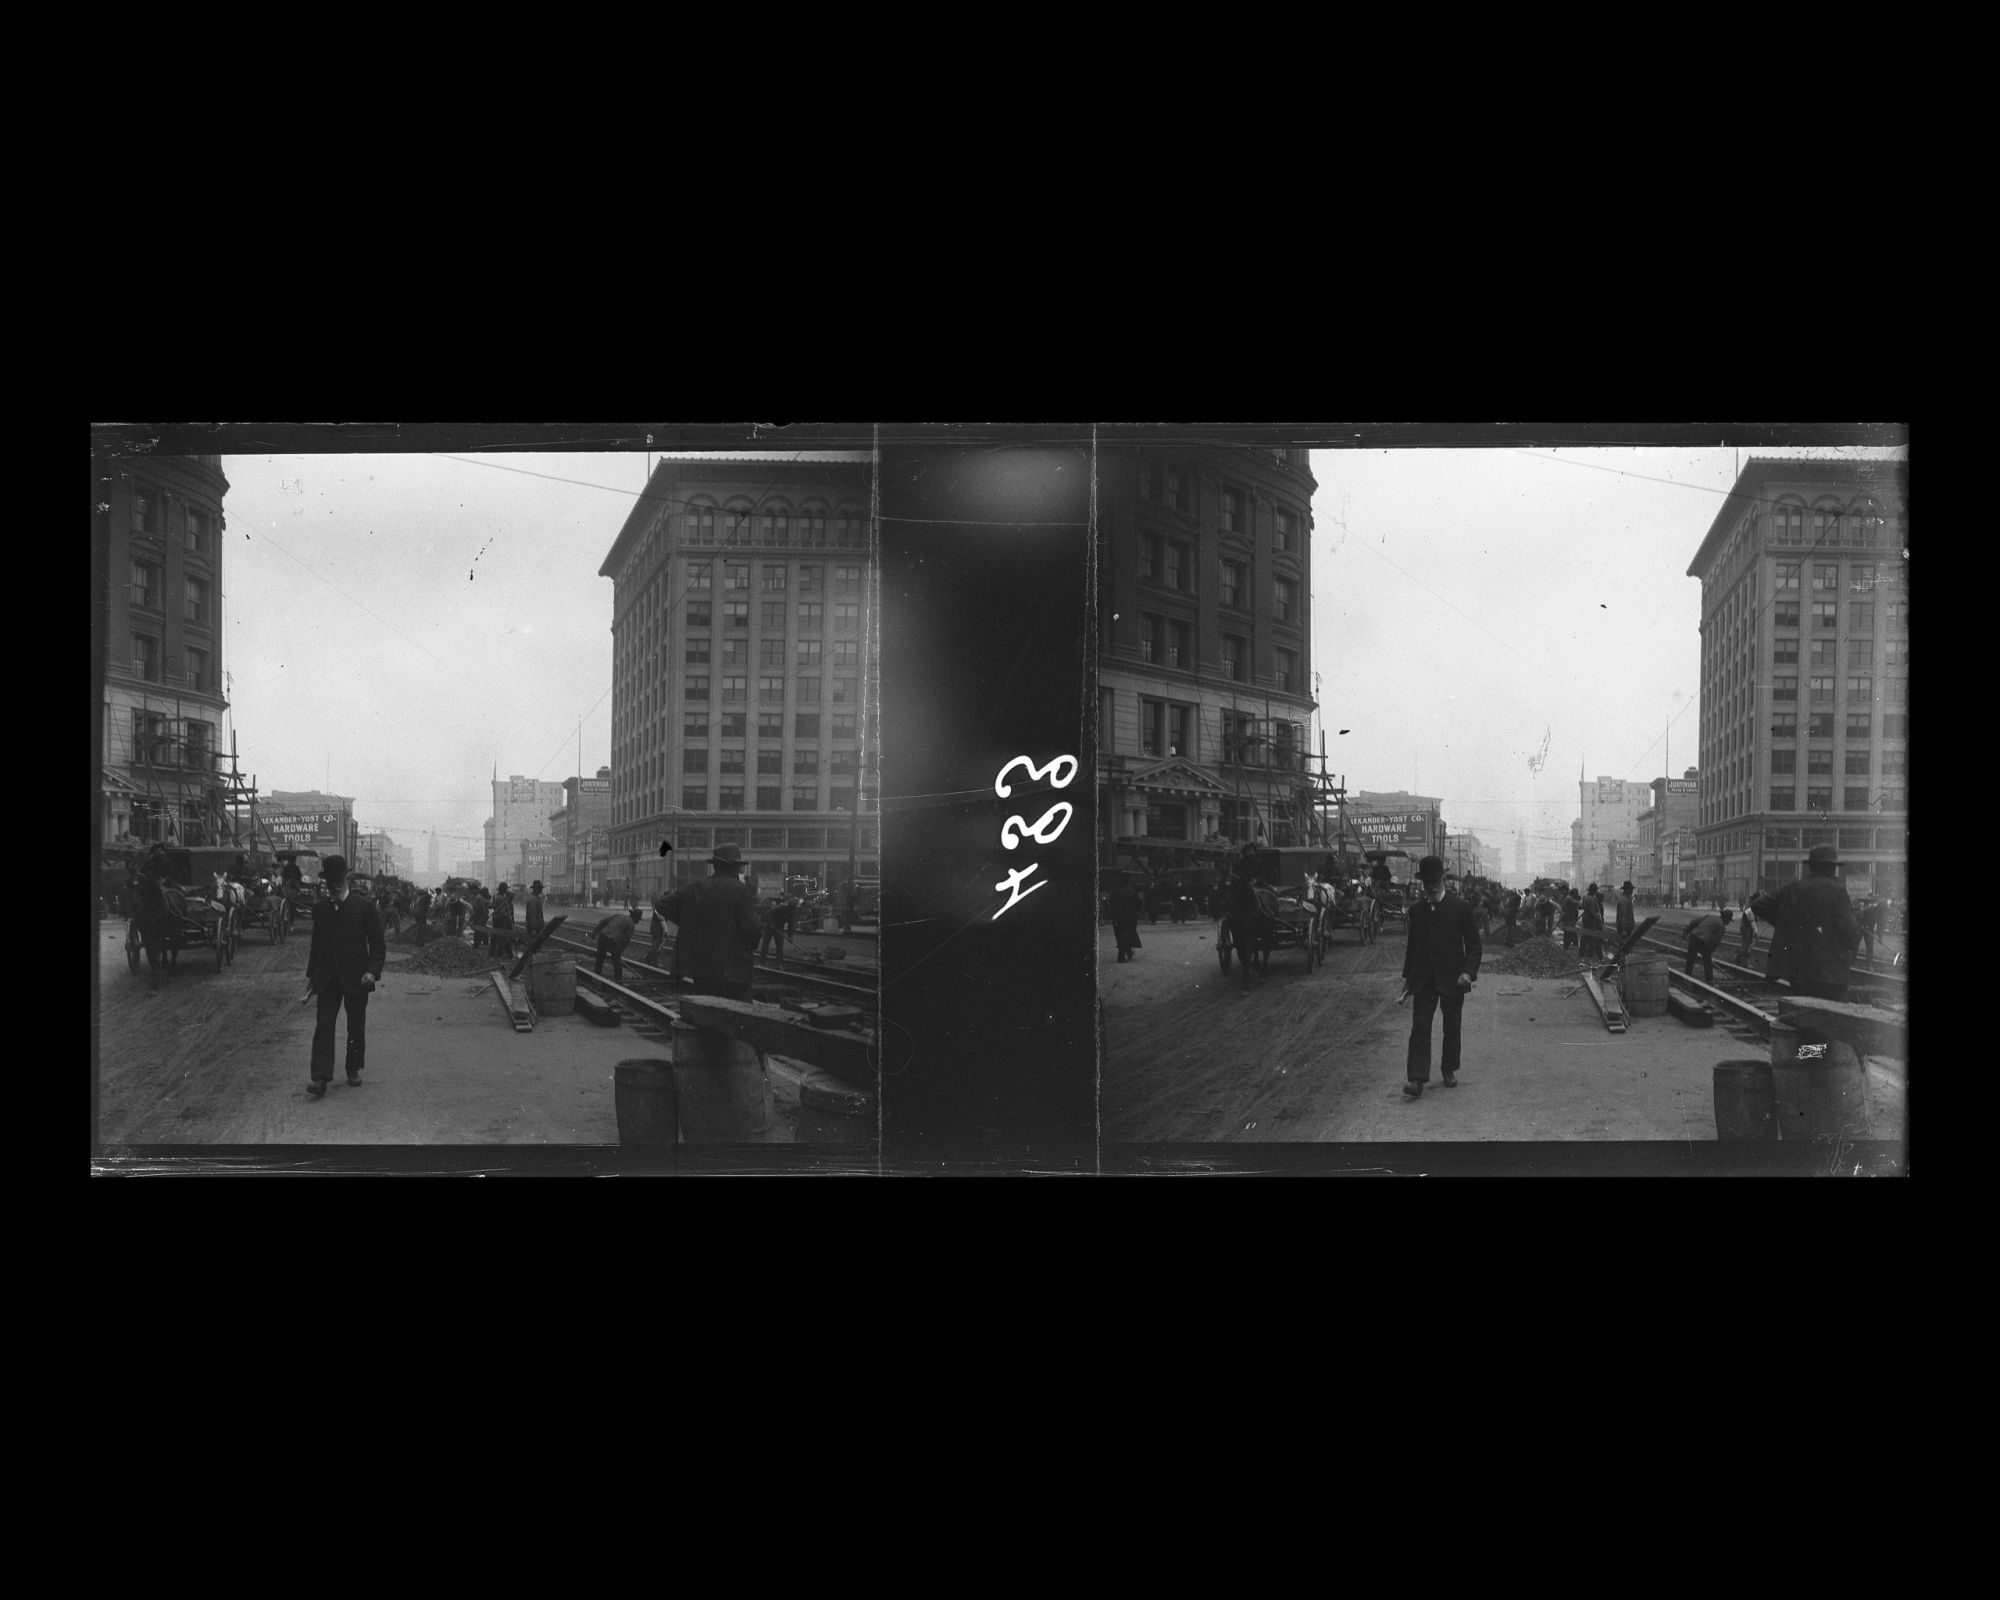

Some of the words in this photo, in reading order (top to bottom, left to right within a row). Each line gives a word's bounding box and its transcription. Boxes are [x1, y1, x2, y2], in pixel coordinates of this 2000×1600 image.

[273, 823, 319, 833] HARDWARE
[1361, 823, 1407, 833] HARDWARE
[283, 833, 311, 843] TOOLS
[1371, 834, 1399, 843] TOOLS
